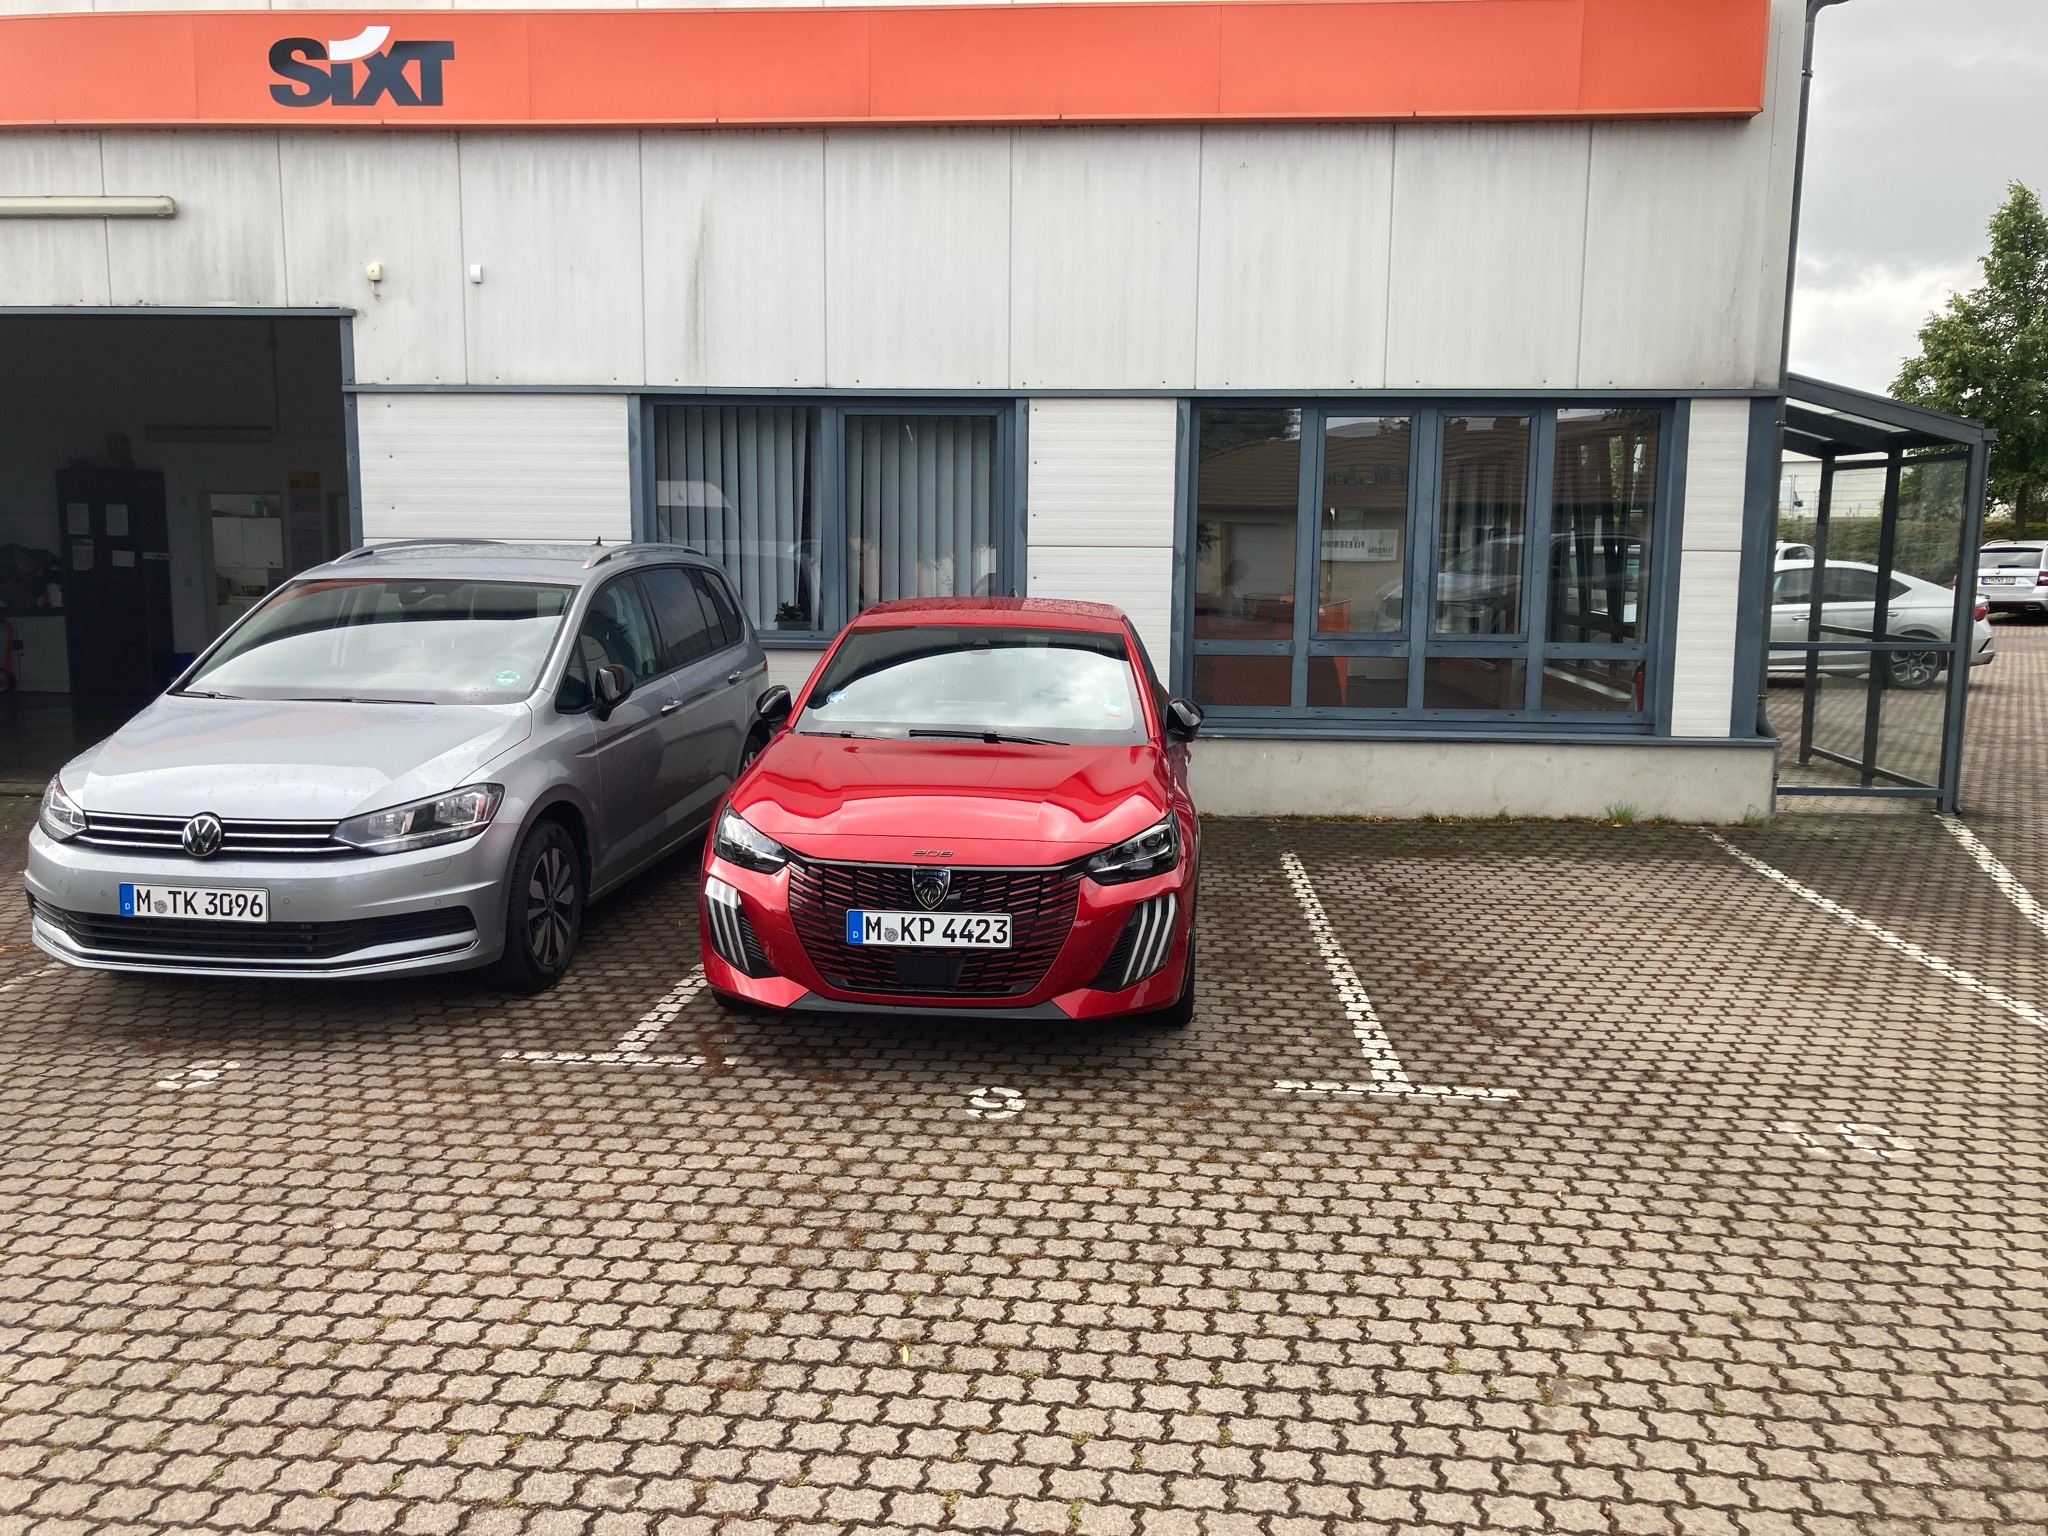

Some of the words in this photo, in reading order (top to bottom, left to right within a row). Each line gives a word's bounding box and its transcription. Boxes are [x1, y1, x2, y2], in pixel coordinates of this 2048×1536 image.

[136, 889, 151, 912] M
[168, 890, 198, 915] TK
[204, 892, 263, 918] 3096
[852, 930, 859, 939] D
[865, 916, 882, 941] M
[901, 917, 935, 943] KP
[942, 918, 1008, 944] 4423
